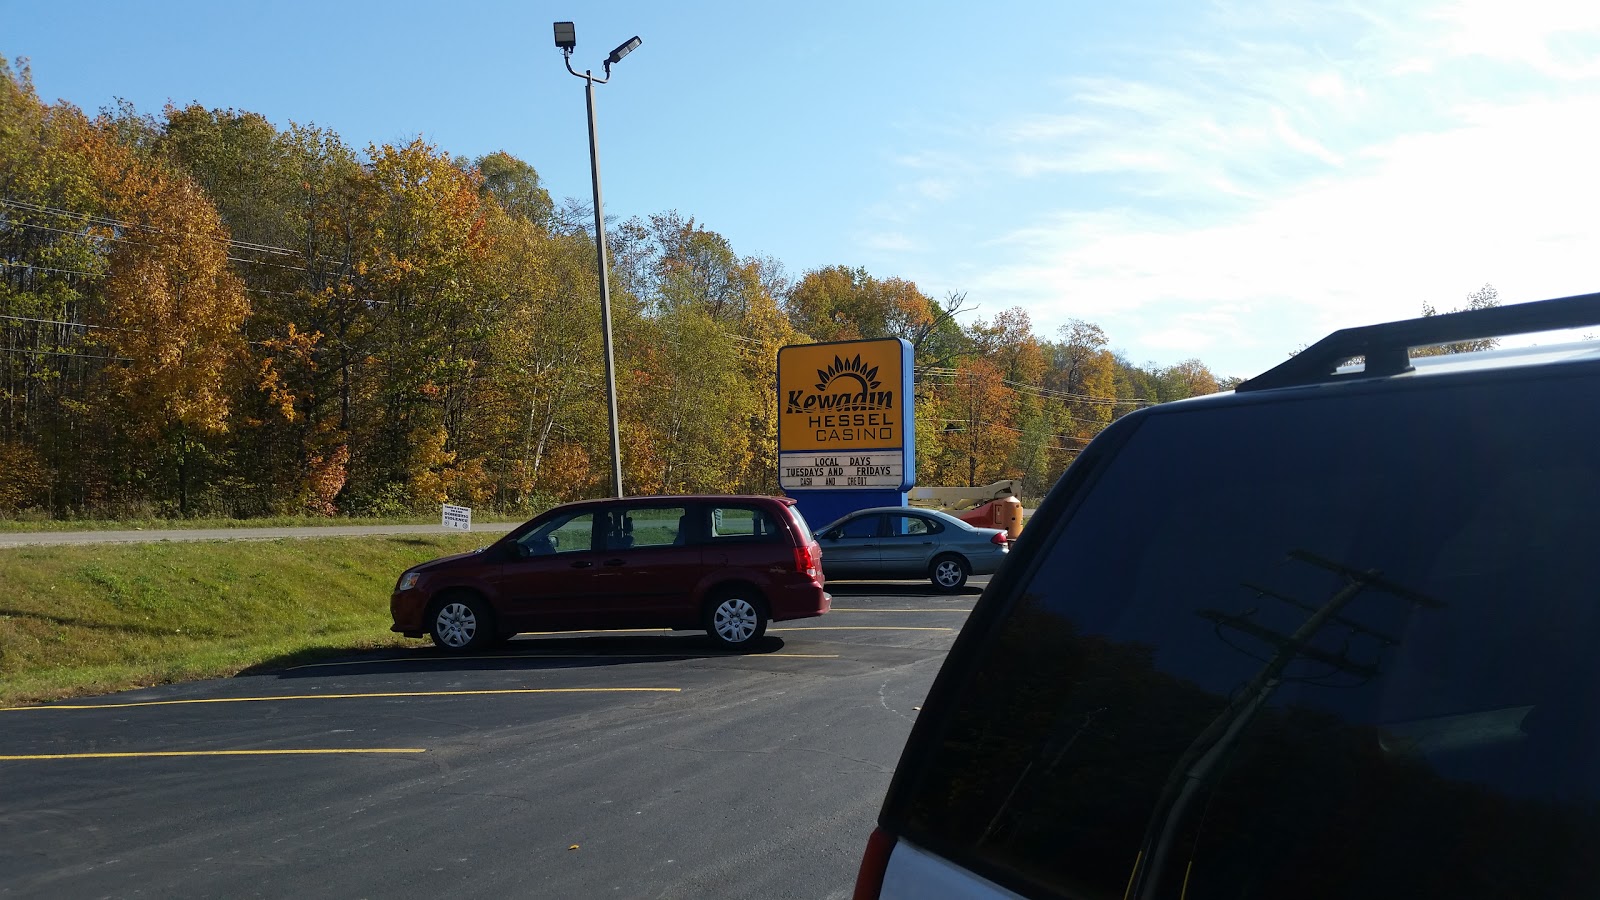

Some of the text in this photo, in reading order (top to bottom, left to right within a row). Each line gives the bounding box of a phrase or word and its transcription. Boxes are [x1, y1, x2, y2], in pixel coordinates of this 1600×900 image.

[786, 390, 892, 413] Kewadin
[809, 414, 893, 427] HESSEL
[816, 428, 892, 441] CASINO
[815, 457, 871, 466] LOCAL DAYS
[786, 466, 891, 477] TUESDAYS AND FRIDAYS
[800, 477, 813, 486] CASH
[825, 477, 836, 486] AND
